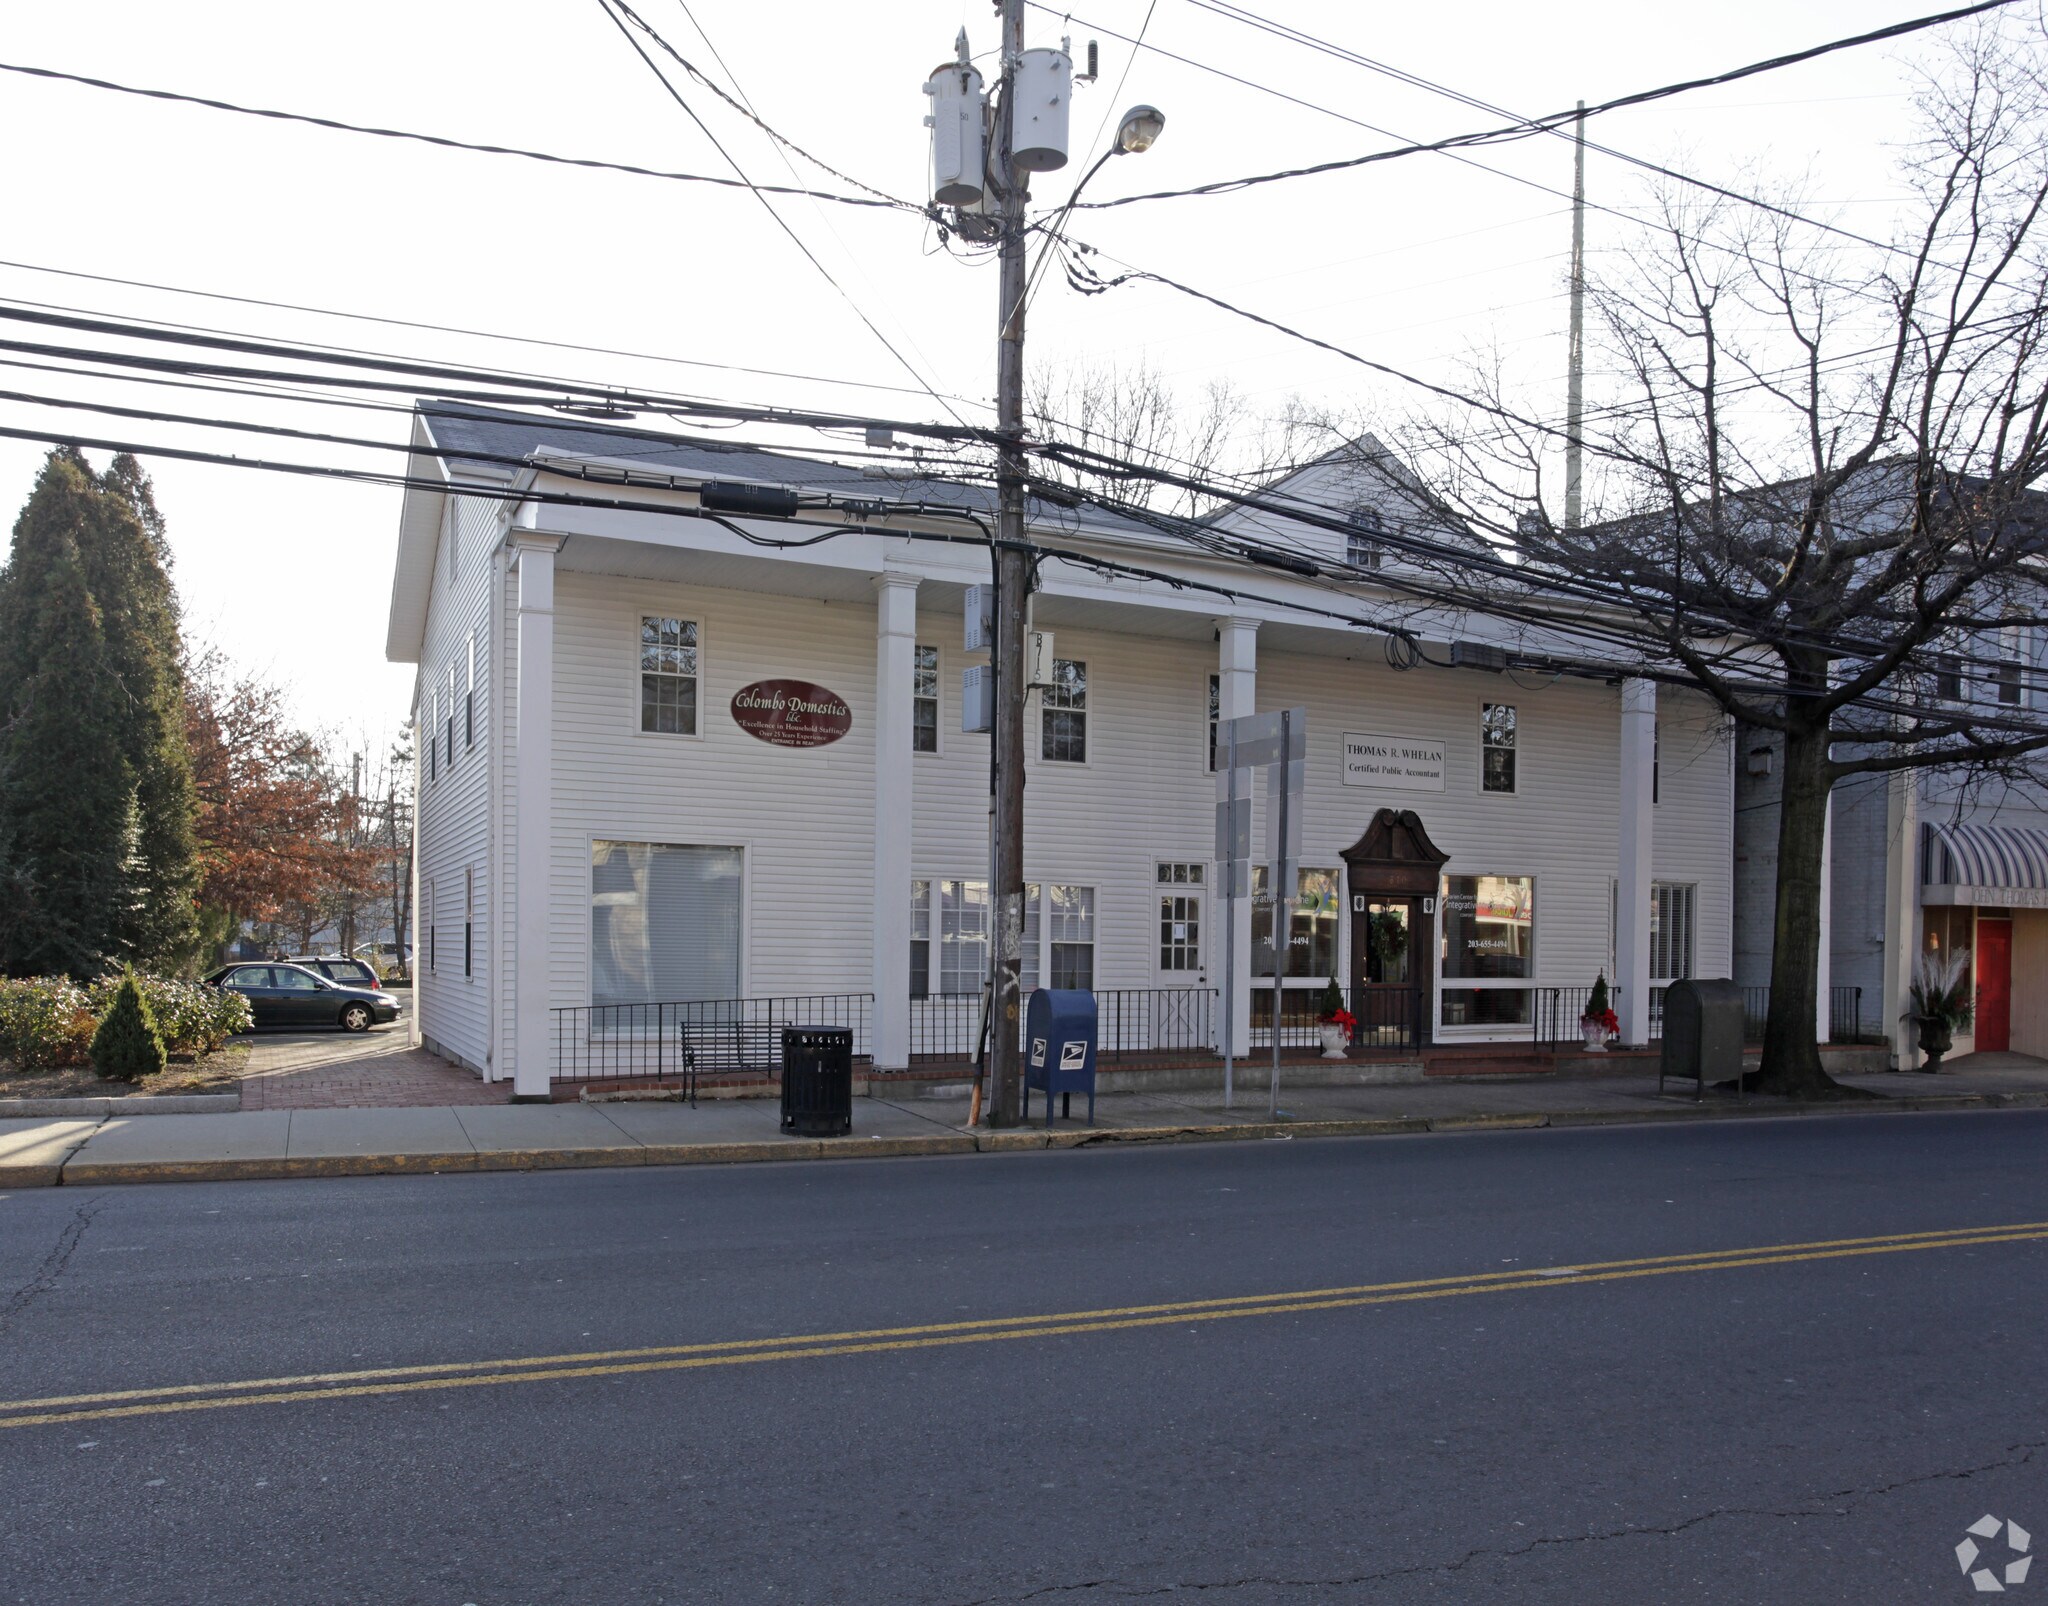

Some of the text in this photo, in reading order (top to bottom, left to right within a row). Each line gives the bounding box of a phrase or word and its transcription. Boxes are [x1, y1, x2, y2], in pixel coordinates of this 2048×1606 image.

[735, 688, 847, 716] Colombo Domestics
[759, 730, 773, 738] Over
[796, 733, 827, 741] Experience
[785, 723, 818, 733] Household
[1347, 744, 1442, 761] THOMAS R. WHELAN
[1348, 763, 1440, 778] Certified Public Accountant
[1970, 887, 2040, 905] JOHN THOMAS
[1467, 939, 1508, 948] 203-655-4494
